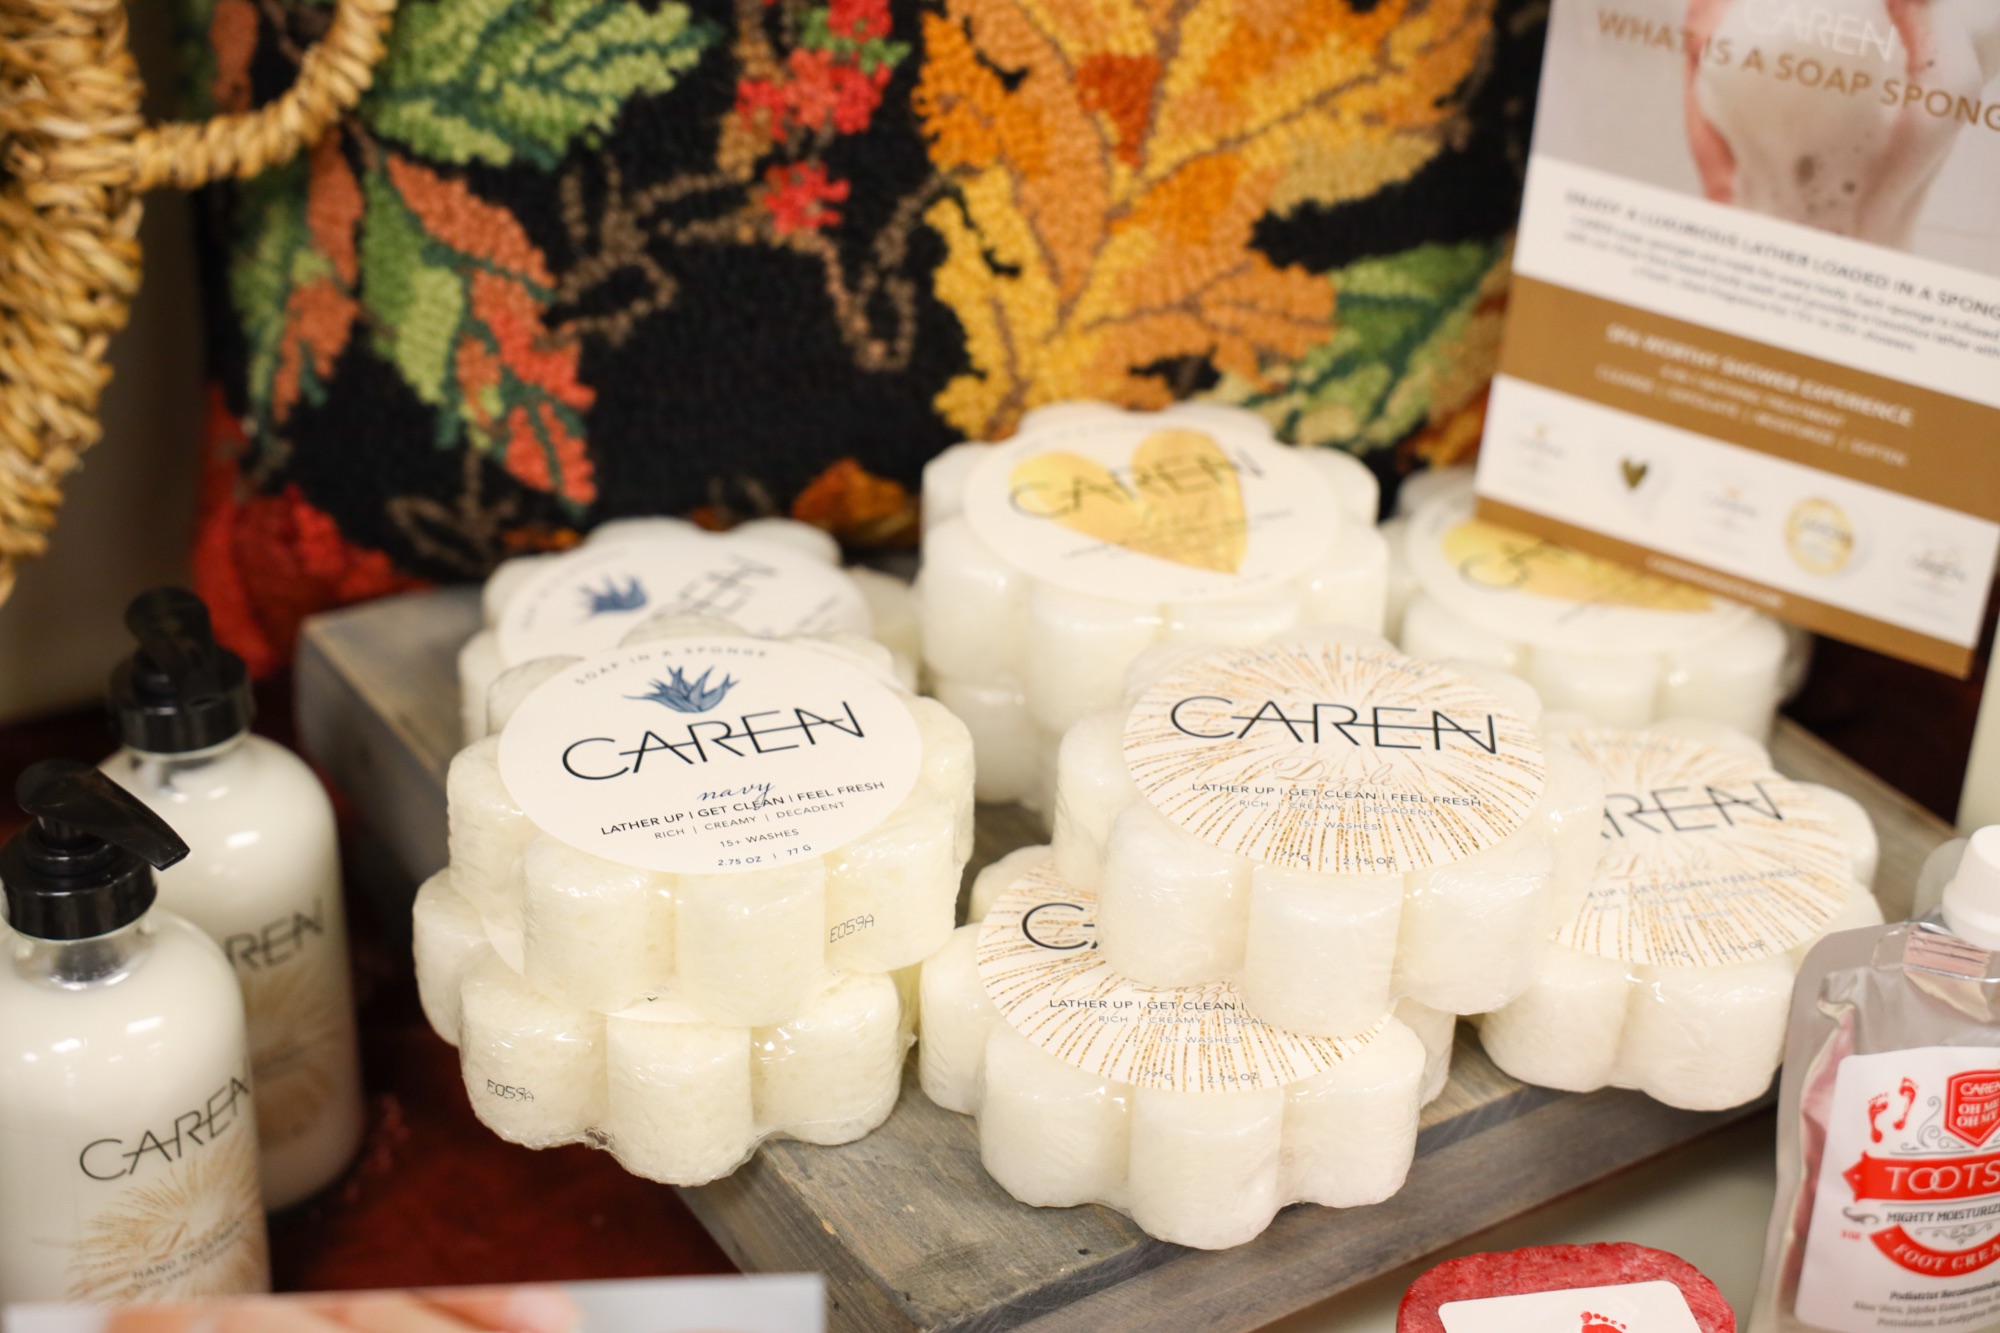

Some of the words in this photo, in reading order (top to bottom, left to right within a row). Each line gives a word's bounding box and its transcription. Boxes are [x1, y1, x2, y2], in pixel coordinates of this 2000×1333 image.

[1597, 9, 1696, 54] WHAT
[1702, 36, 1733, 66] IS
[1740, 46, 1765, 73] A
[1774, 53, 1872, 95] SOAP
[1812, 256, 1888, 290] LOADED
[1893, 279, 1914, 297] IN
[1917, 284, 1931, 301] A
[1800, 379, 1914, 428] EXPERIENCE
[1009, 447, 1265, 520] CAREN
[574, 660, 619, 685] SOAP
[684, 645, 767, 658] SPONGE
[1171, 695, 1497, 754] CAREN
[562, 701, 866, 780] CAREN
[601, 816, 660, 836] LATHER
[664, 812, 684, 824] UP
[697, 804, 728, 818] GET
[733, 796, 785, 812] CLEAN
[797, 788, 834, 802] FEEL
[837, 780, 885, 795] FRESH
[697, 781, 776, 811] navy
[1191, 783, 1250, 794] LATHER
[1254, 786, 1275, 795] UP
[1288, 788, 1318, 798] GET
[1324, 789, 1377, 801] CLEAN
[1391, 793, 1428, 803] FEEL
[1432, 795, 1482, 808] FRESH
[1239, 799, 1269, 808] RICH
[1289, 802, 1343, 811] CREAMY
[1363, 805, 1435, 817] DECADENT
[655, 828, 685, 840] RICH
[704, 815, 757, 831] CREAMY
[776, 800, 845, 819] DECADENT
[1601, 782, 1784, 839] REN
[719, 838, 742, 848] 15+
[746, 828, 800, 844] WASHES
[1323, 821, 1379, 831] WASHES
[718, 858, 742, 866] 2.75
[745, 855, 763, 865] OZ
[786, 847, 799, 856] 77
[802, 844, 812, 852] G
[829, 913, 875, 944] E059A
[1049, 999, 1108, 1009] LATHER
[1113, 1000, 1133, 1010] UP
[1146, 1001, 1178, 1011] GET
[1182, 1001, 1236, 1012] CLEAN
[1098, 1015, 1129, 1024] RICH
[1148, 1016, 1202, 1025] CREAMY
[1184, 1036, 1240, 1045] WASHES
[487, 1079, 535, 1102] E059A
[1956, 1115, 1979, 1128] OH
[1958, 1102, 1981, 1116] OH
[1887, 1210, 1935, 1224] MIGHTY
[1893, 1243, 1947, 1271] FOOT
